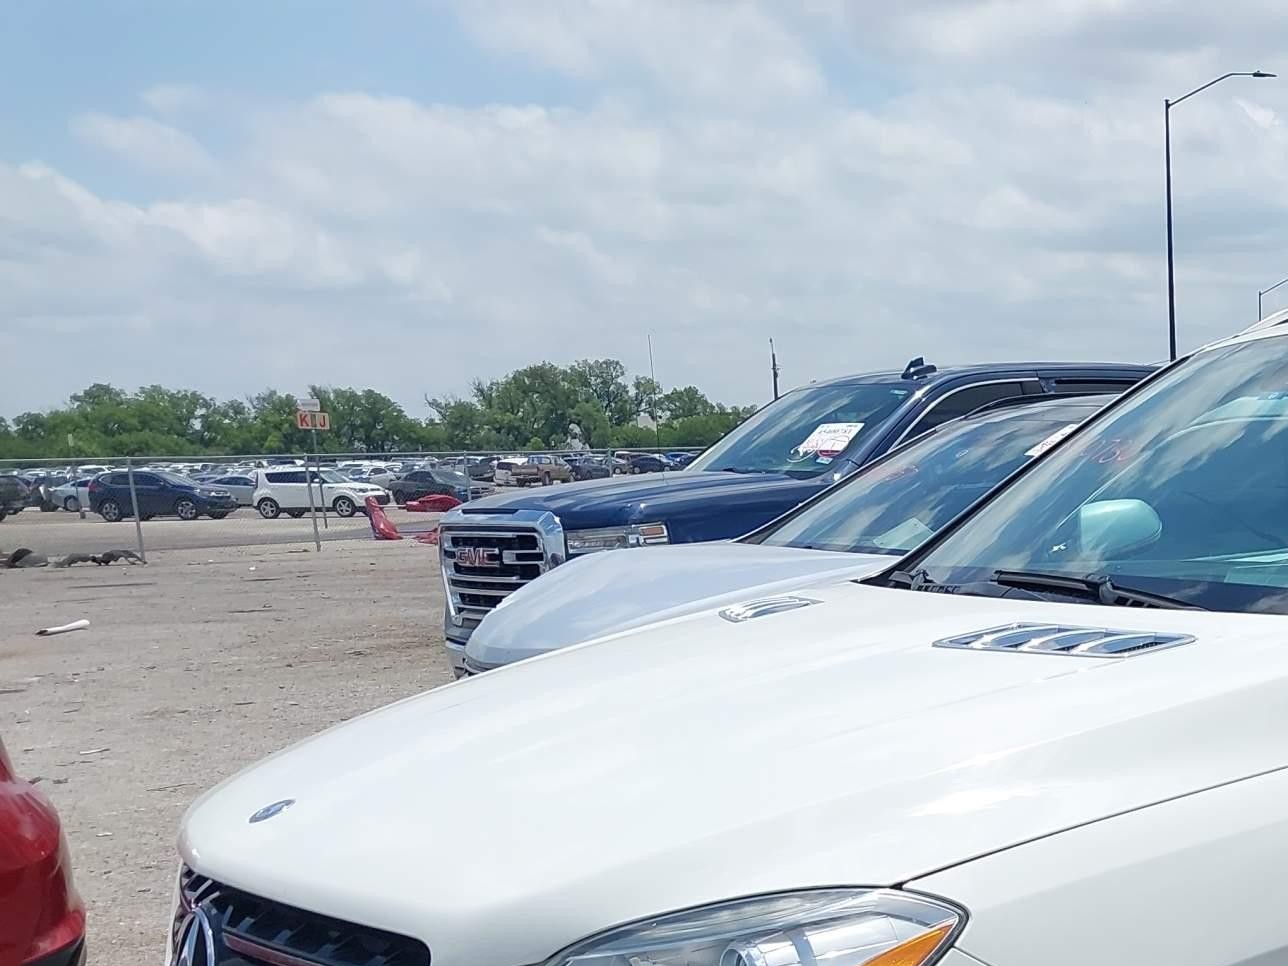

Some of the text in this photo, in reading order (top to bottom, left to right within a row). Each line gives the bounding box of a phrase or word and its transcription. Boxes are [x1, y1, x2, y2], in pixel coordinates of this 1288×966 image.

[299, 413, 326, 428] K J
[456, 547, 500, 568] GMC
